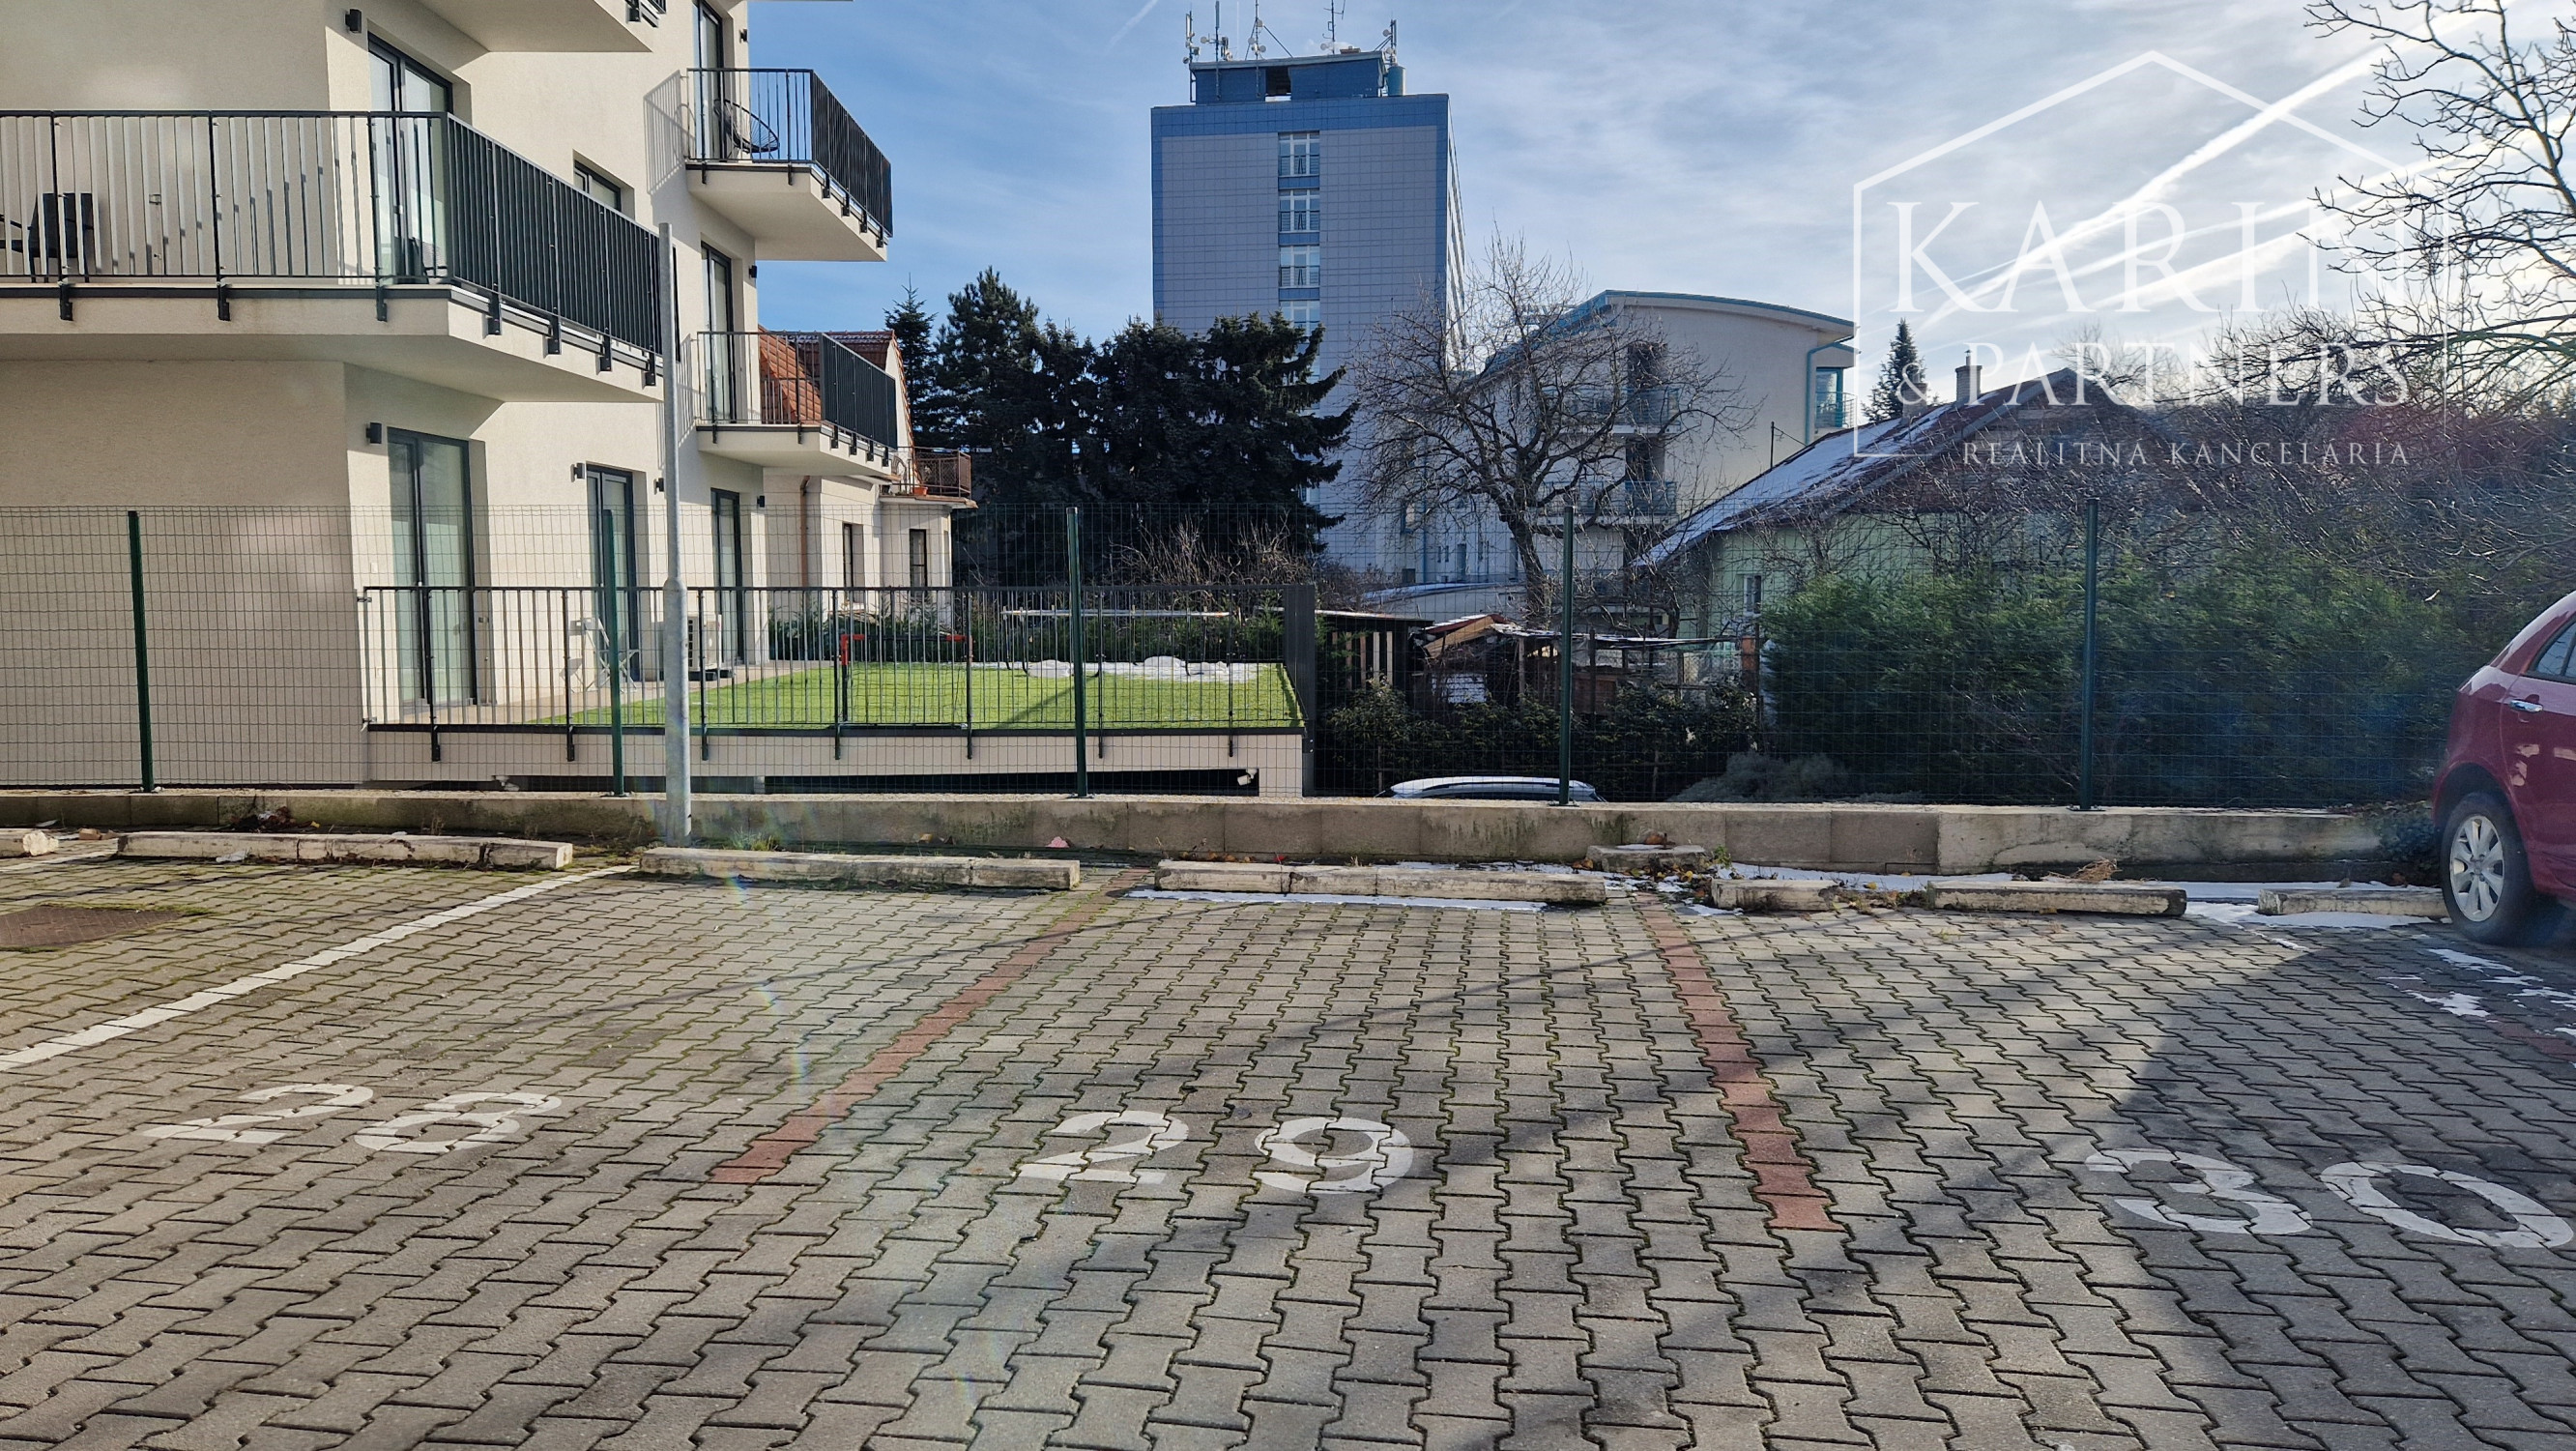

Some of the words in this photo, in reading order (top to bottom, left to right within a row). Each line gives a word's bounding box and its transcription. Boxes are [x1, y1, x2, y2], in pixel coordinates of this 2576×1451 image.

[140, 1082, 563, 1153] 28
[1013, 1109, 1414, 1196] 29
[2083, 1148, 2575, 1249] 30
